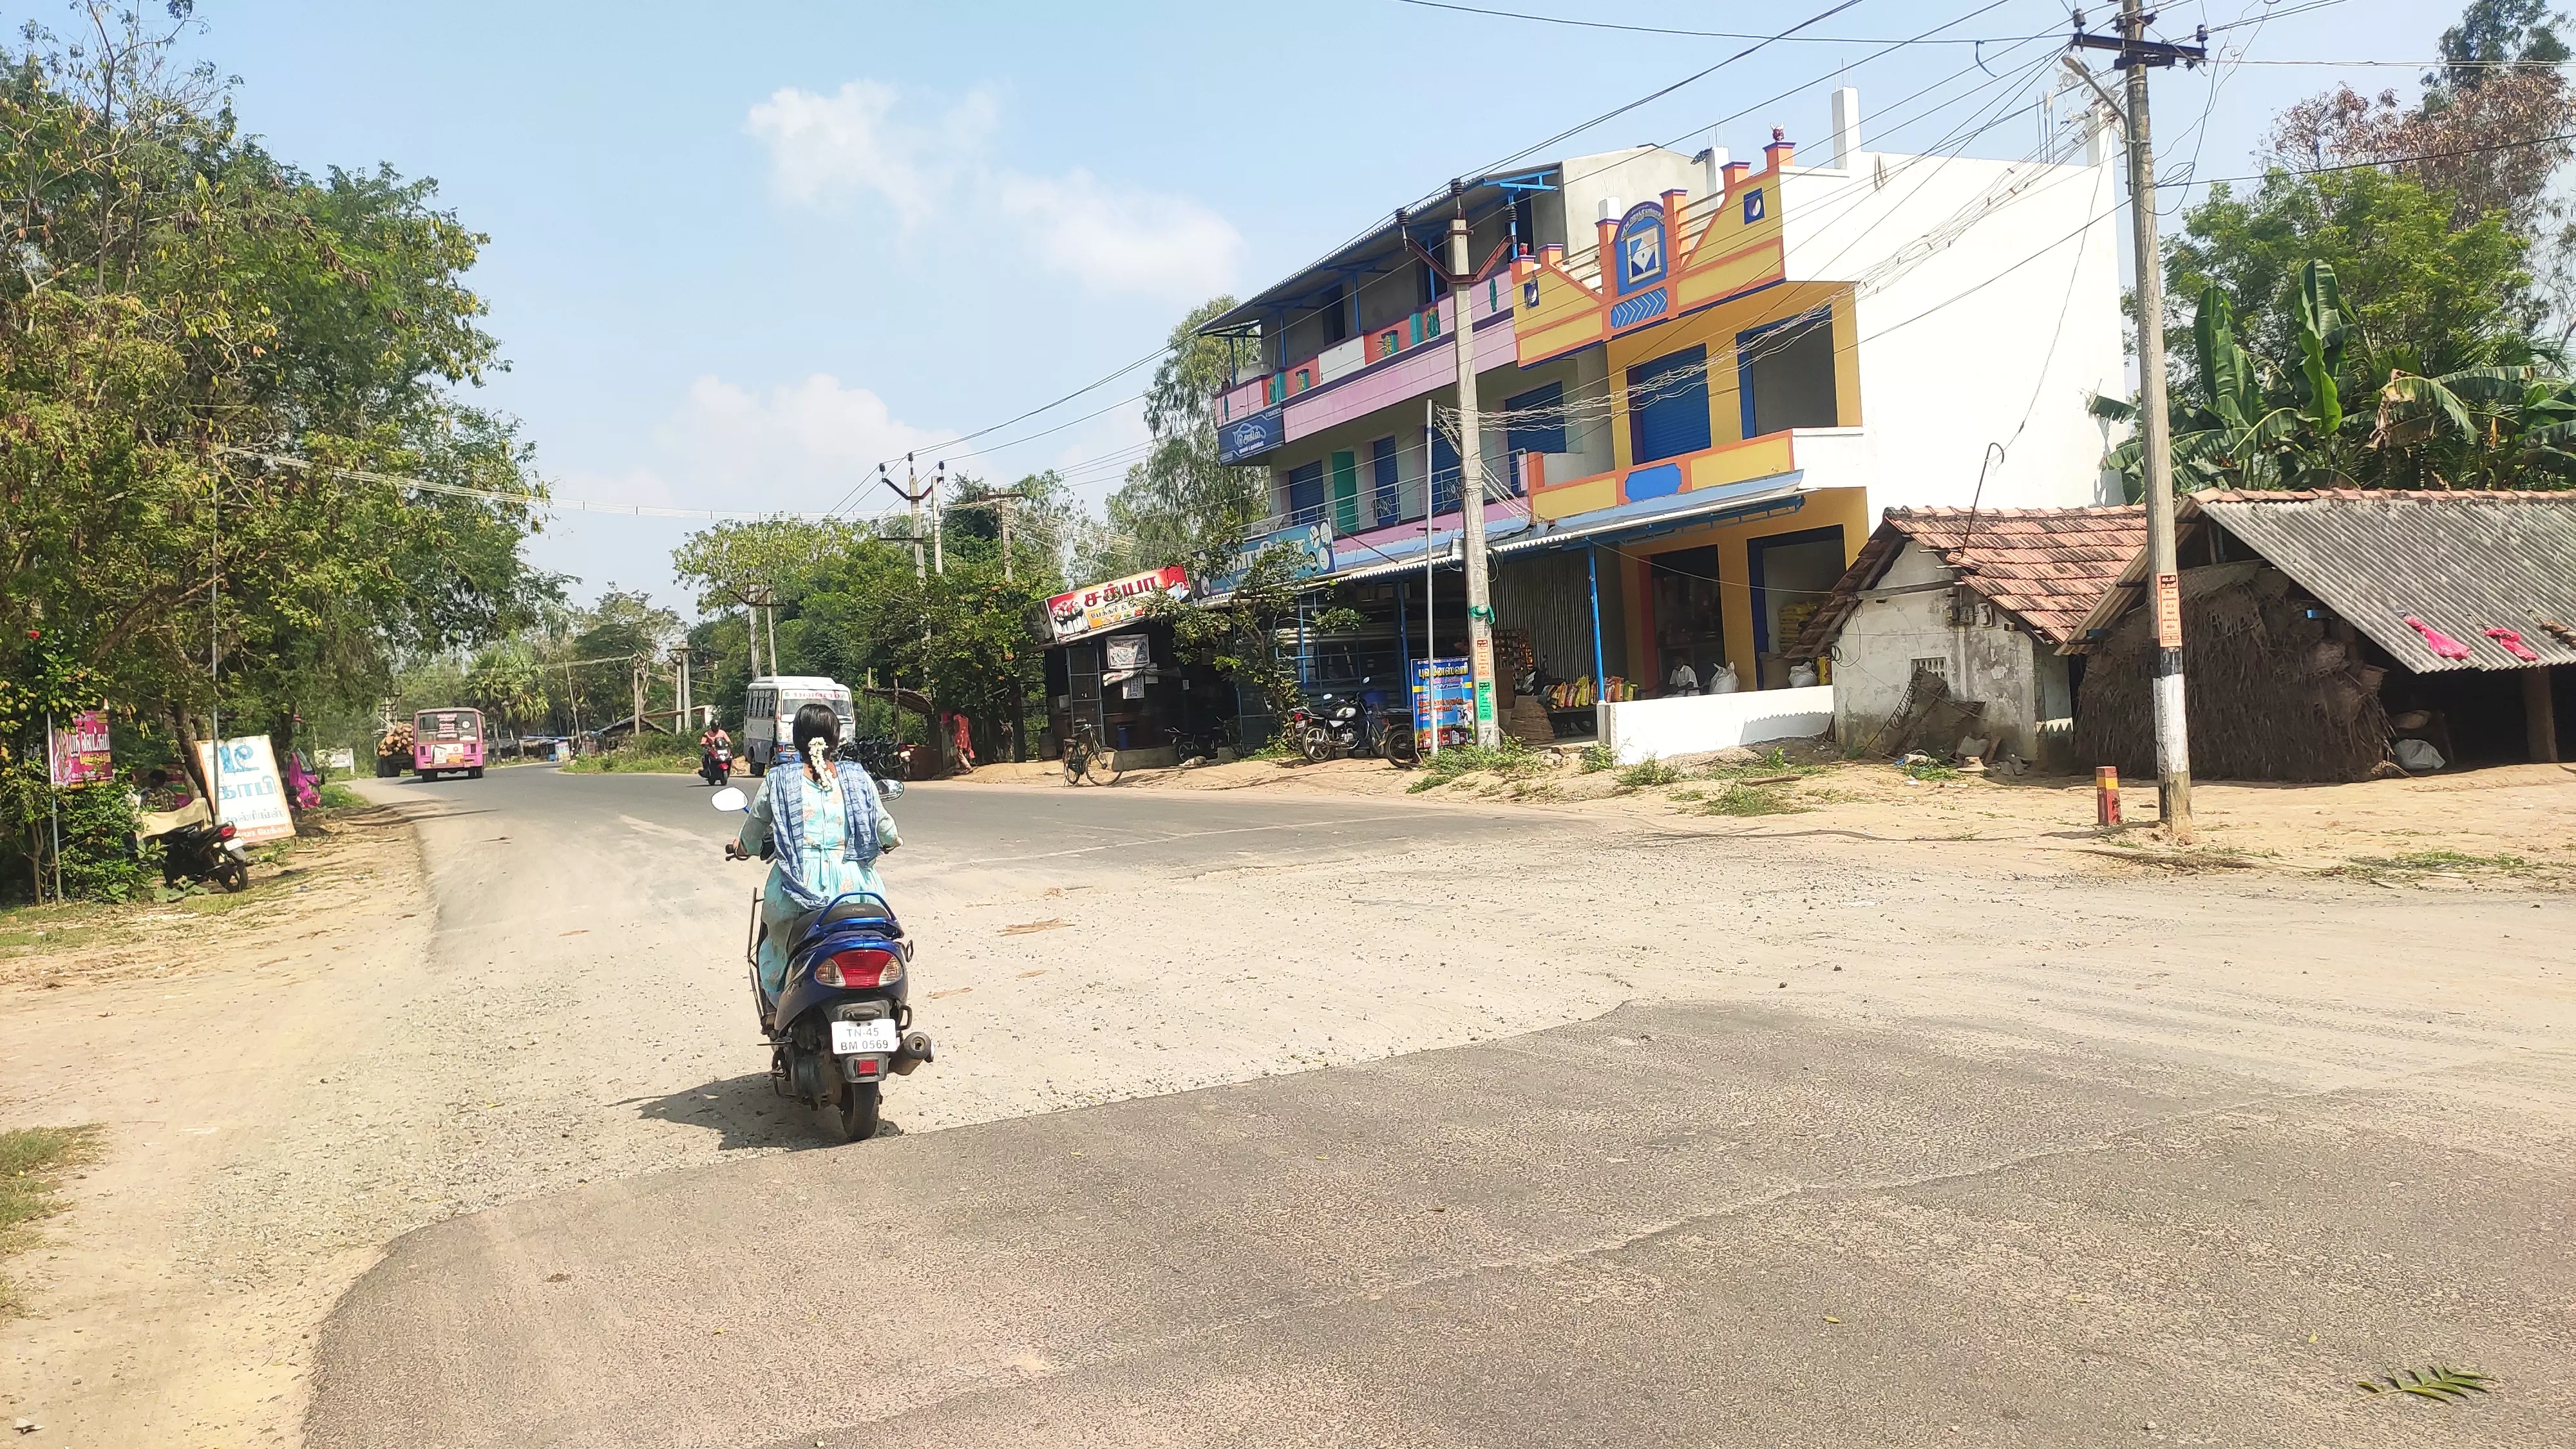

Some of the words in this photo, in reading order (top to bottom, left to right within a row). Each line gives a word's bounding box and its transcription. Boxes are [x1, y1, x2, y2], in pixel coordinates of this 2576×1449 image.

[218, 745, 260, 773] டீ
[219, 775, 278, 800] காபி
[846, 1027, 879, 1037] TN-45
[840, 1041, 858, 1051] BM
[862, 1039, 888, 1049] 0569
